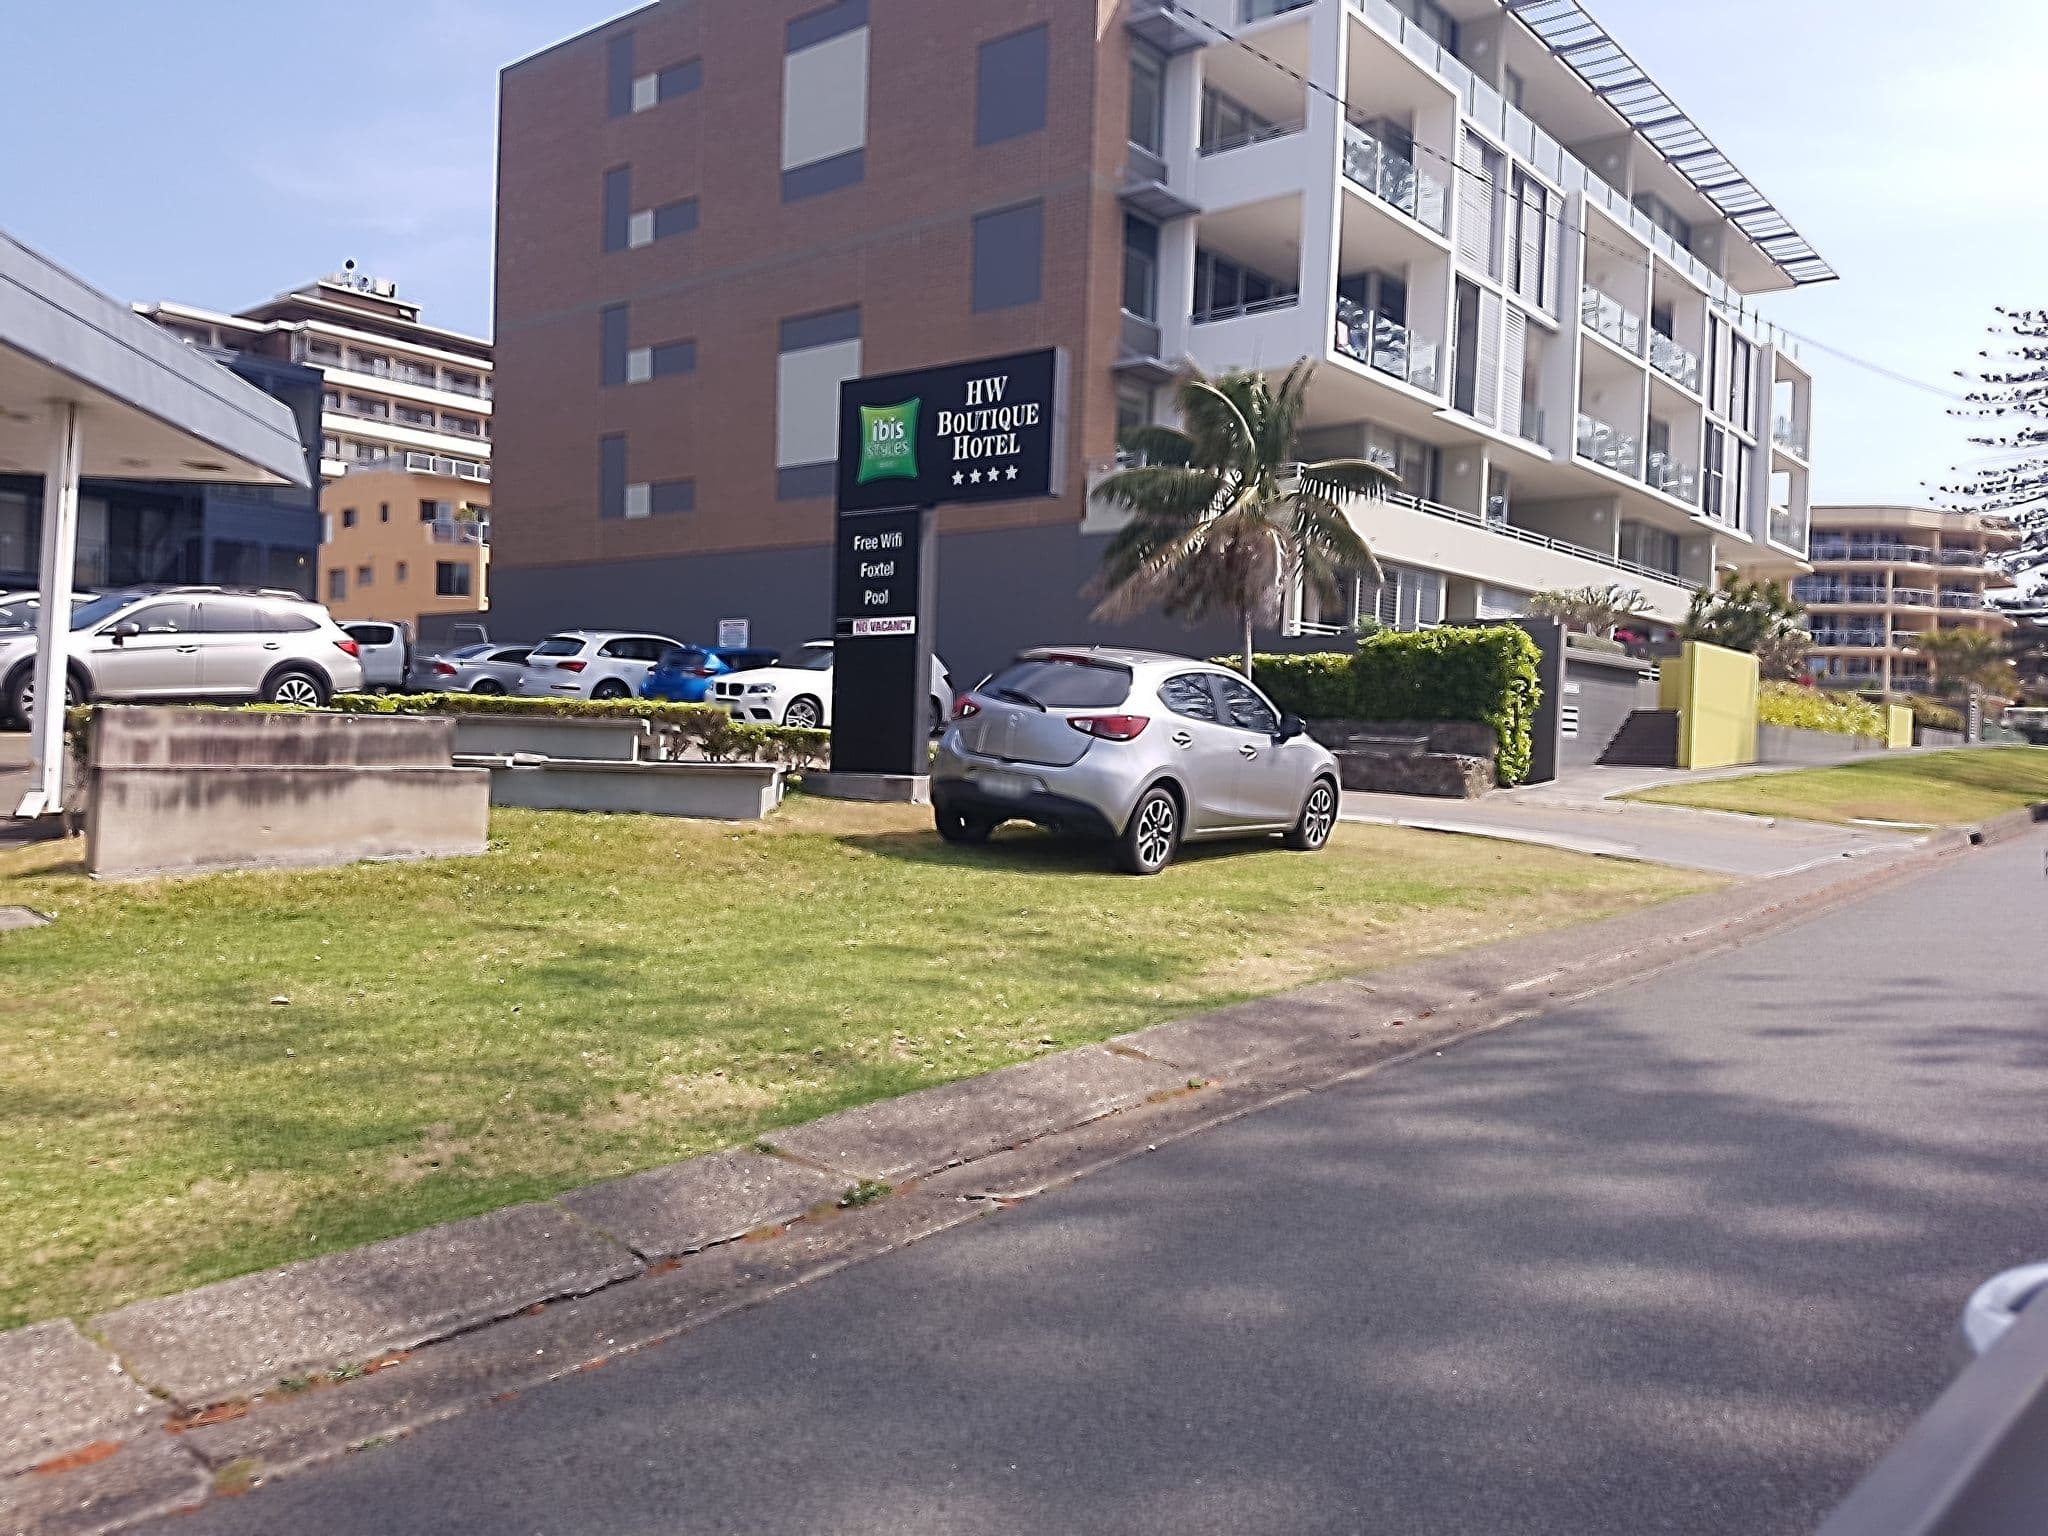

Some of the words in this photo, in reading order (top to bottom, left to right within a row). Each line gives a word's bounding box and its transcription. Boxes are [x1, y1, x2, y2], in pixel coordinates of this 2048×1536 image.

[965, 375, 1008, 406] HW
[872, 416, 905, 442] ibis
[936, 402, 1040, 437] BOUTIQUE
[952, 432, 1021, 461] HOTEL
[853, 535, 879, 551] Free
[880, 532, 903, 549] Wifi
[860, 560, 895, 578] Foxtel
[864, 588, 889, 606] Pool
[855, 621, 868, 633] NO
[870, 620, 912, 632] VACANCY
